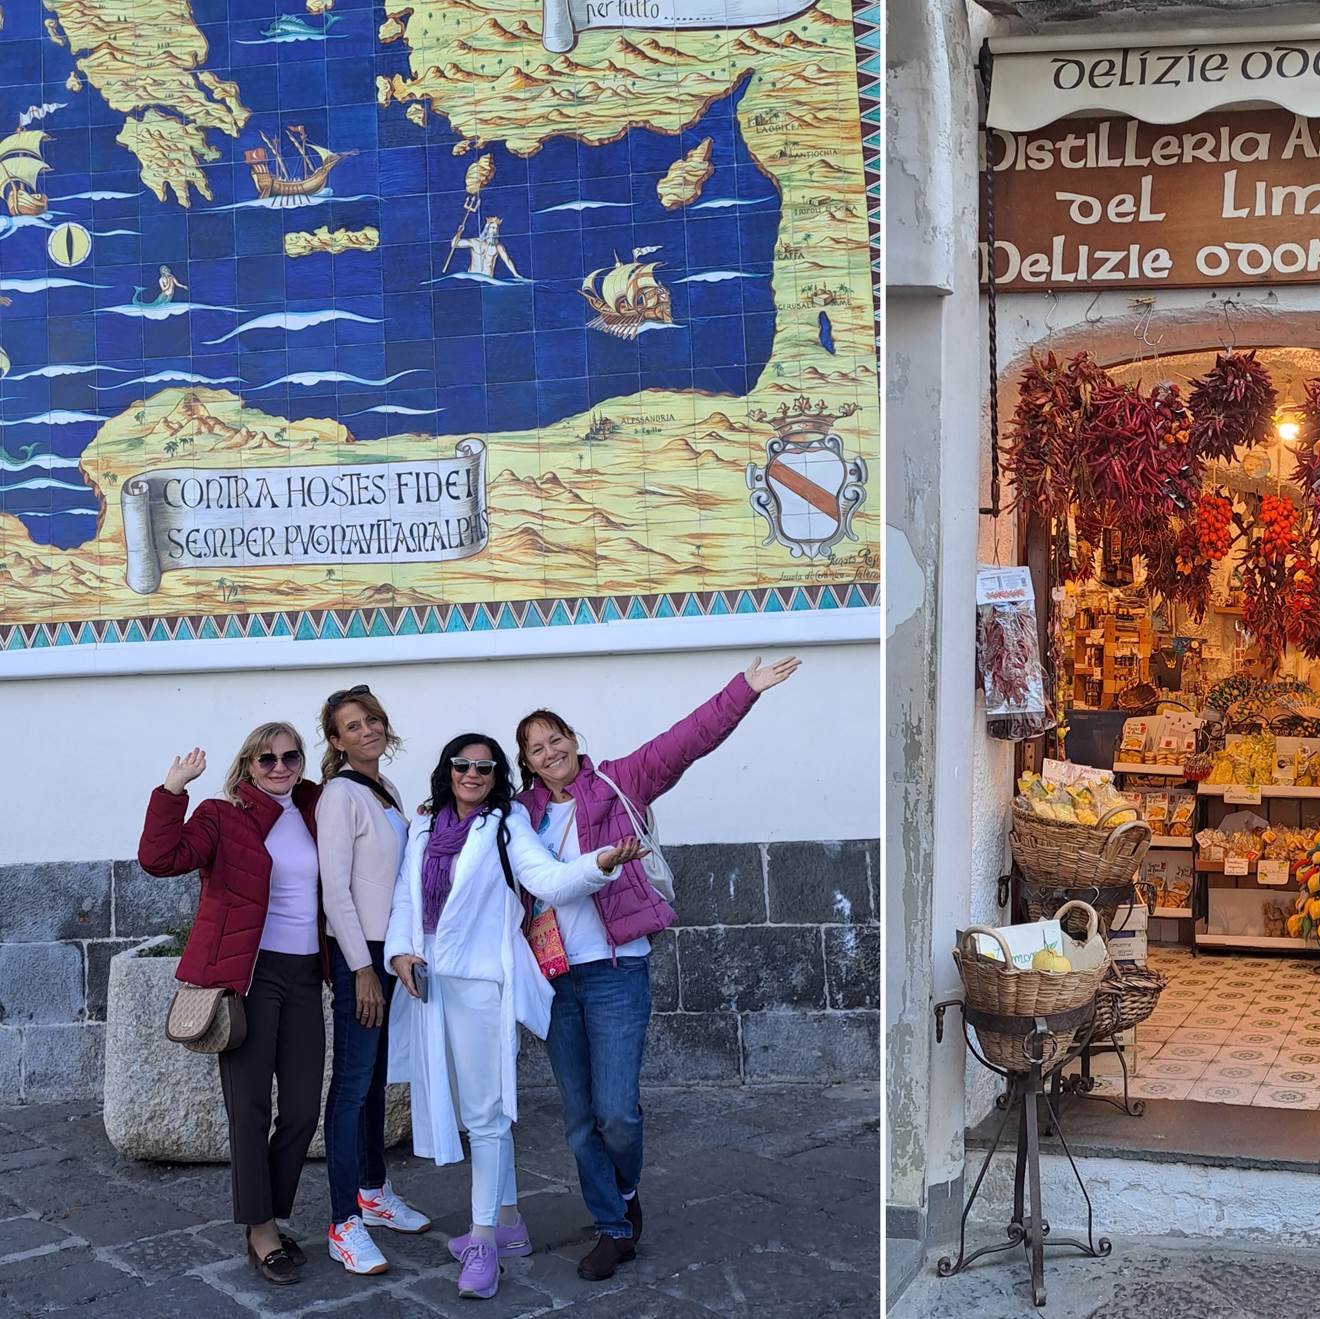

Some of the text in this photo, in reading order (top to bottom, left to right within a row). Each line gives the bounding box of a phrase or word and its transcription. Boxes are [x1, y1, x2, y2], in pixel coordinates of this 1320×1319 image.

[163, 468, 474, 510] CONTRA HOSTES FIDEI
[167, 525, 278, 560] SEMPER
